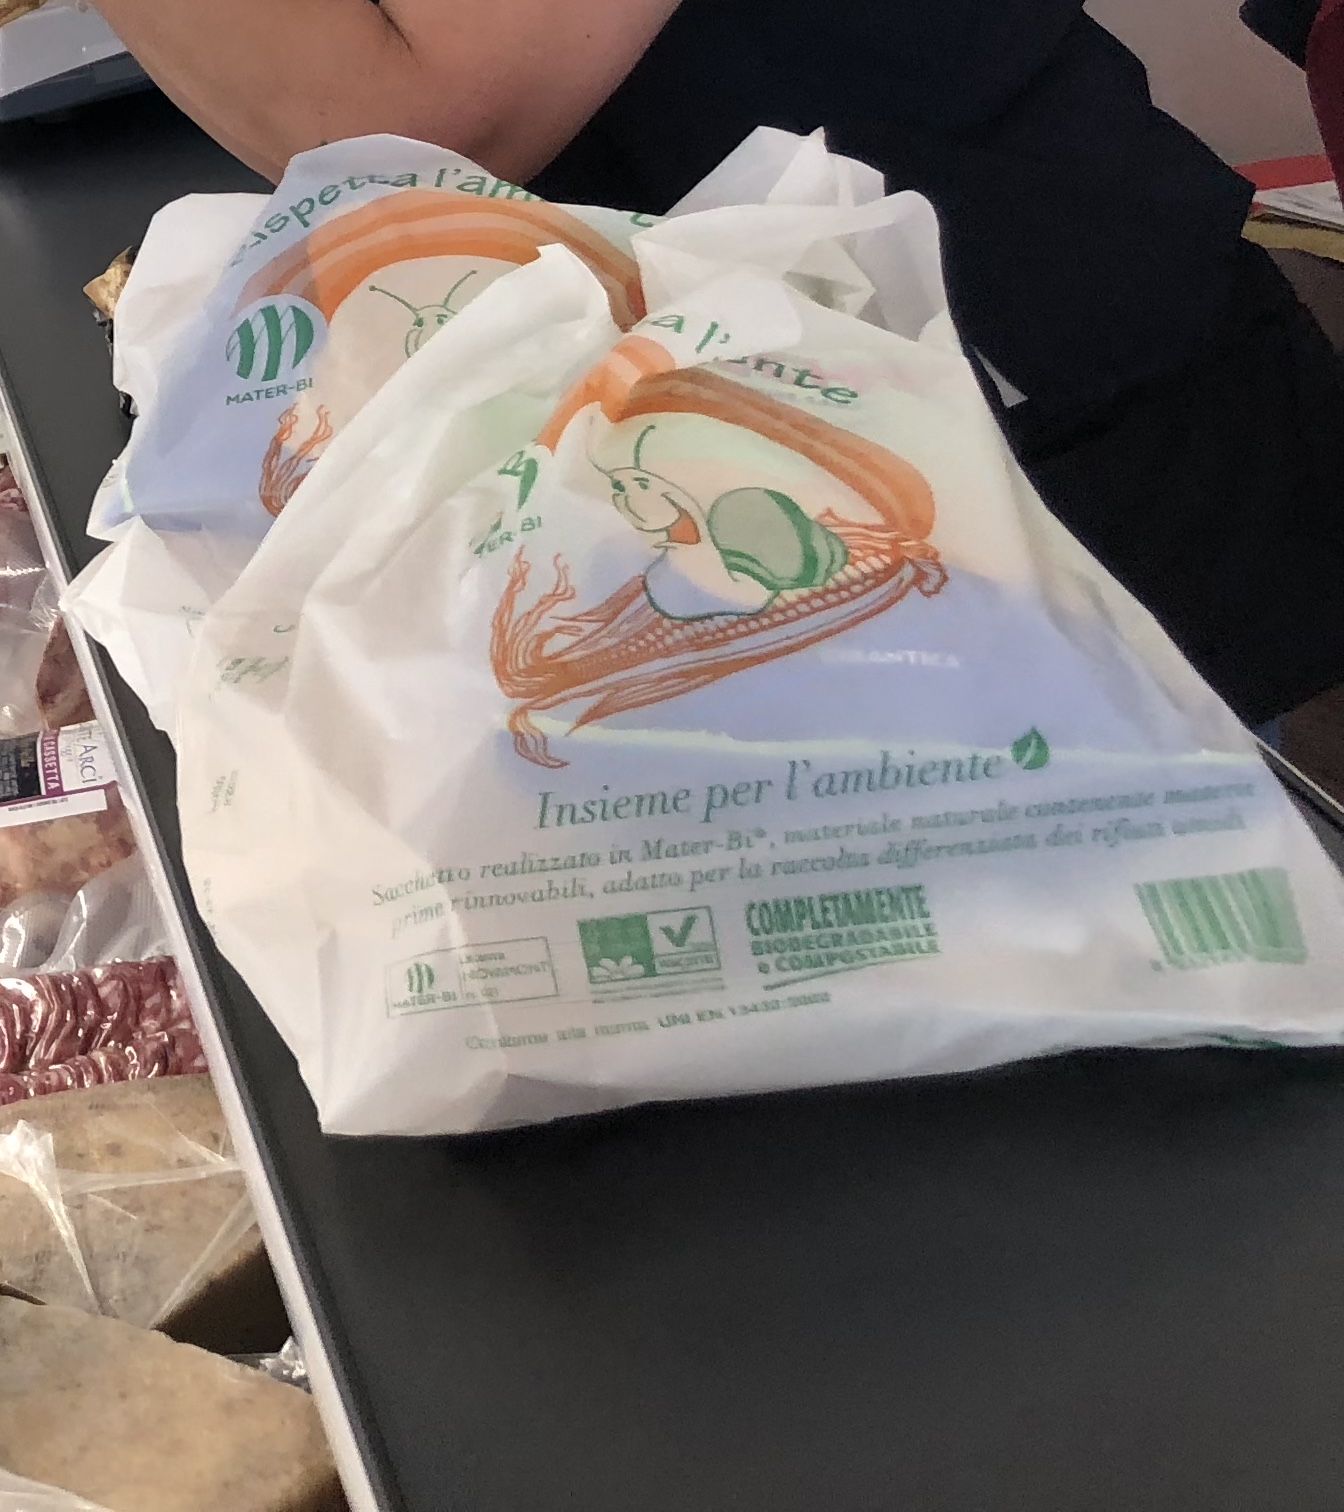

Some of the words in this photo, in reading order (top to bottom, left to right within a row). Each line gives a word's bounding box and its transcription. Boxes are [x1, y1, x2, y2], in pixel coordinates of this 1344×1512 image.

[225, 377, 314, 406] MATER-BI
[534, 784, 692, 830] Insieme
[700, 778, 773, 824] per
[785, 749, 1004, 801] l'ambiente
[479, 851, 601, 879] realizzato
[608, 843, 633, 865] in
[688, 866, 731, 892] per
[738, 856, 763, 880] la
[745, 884, 931, 936] COMPLETAMENTE
